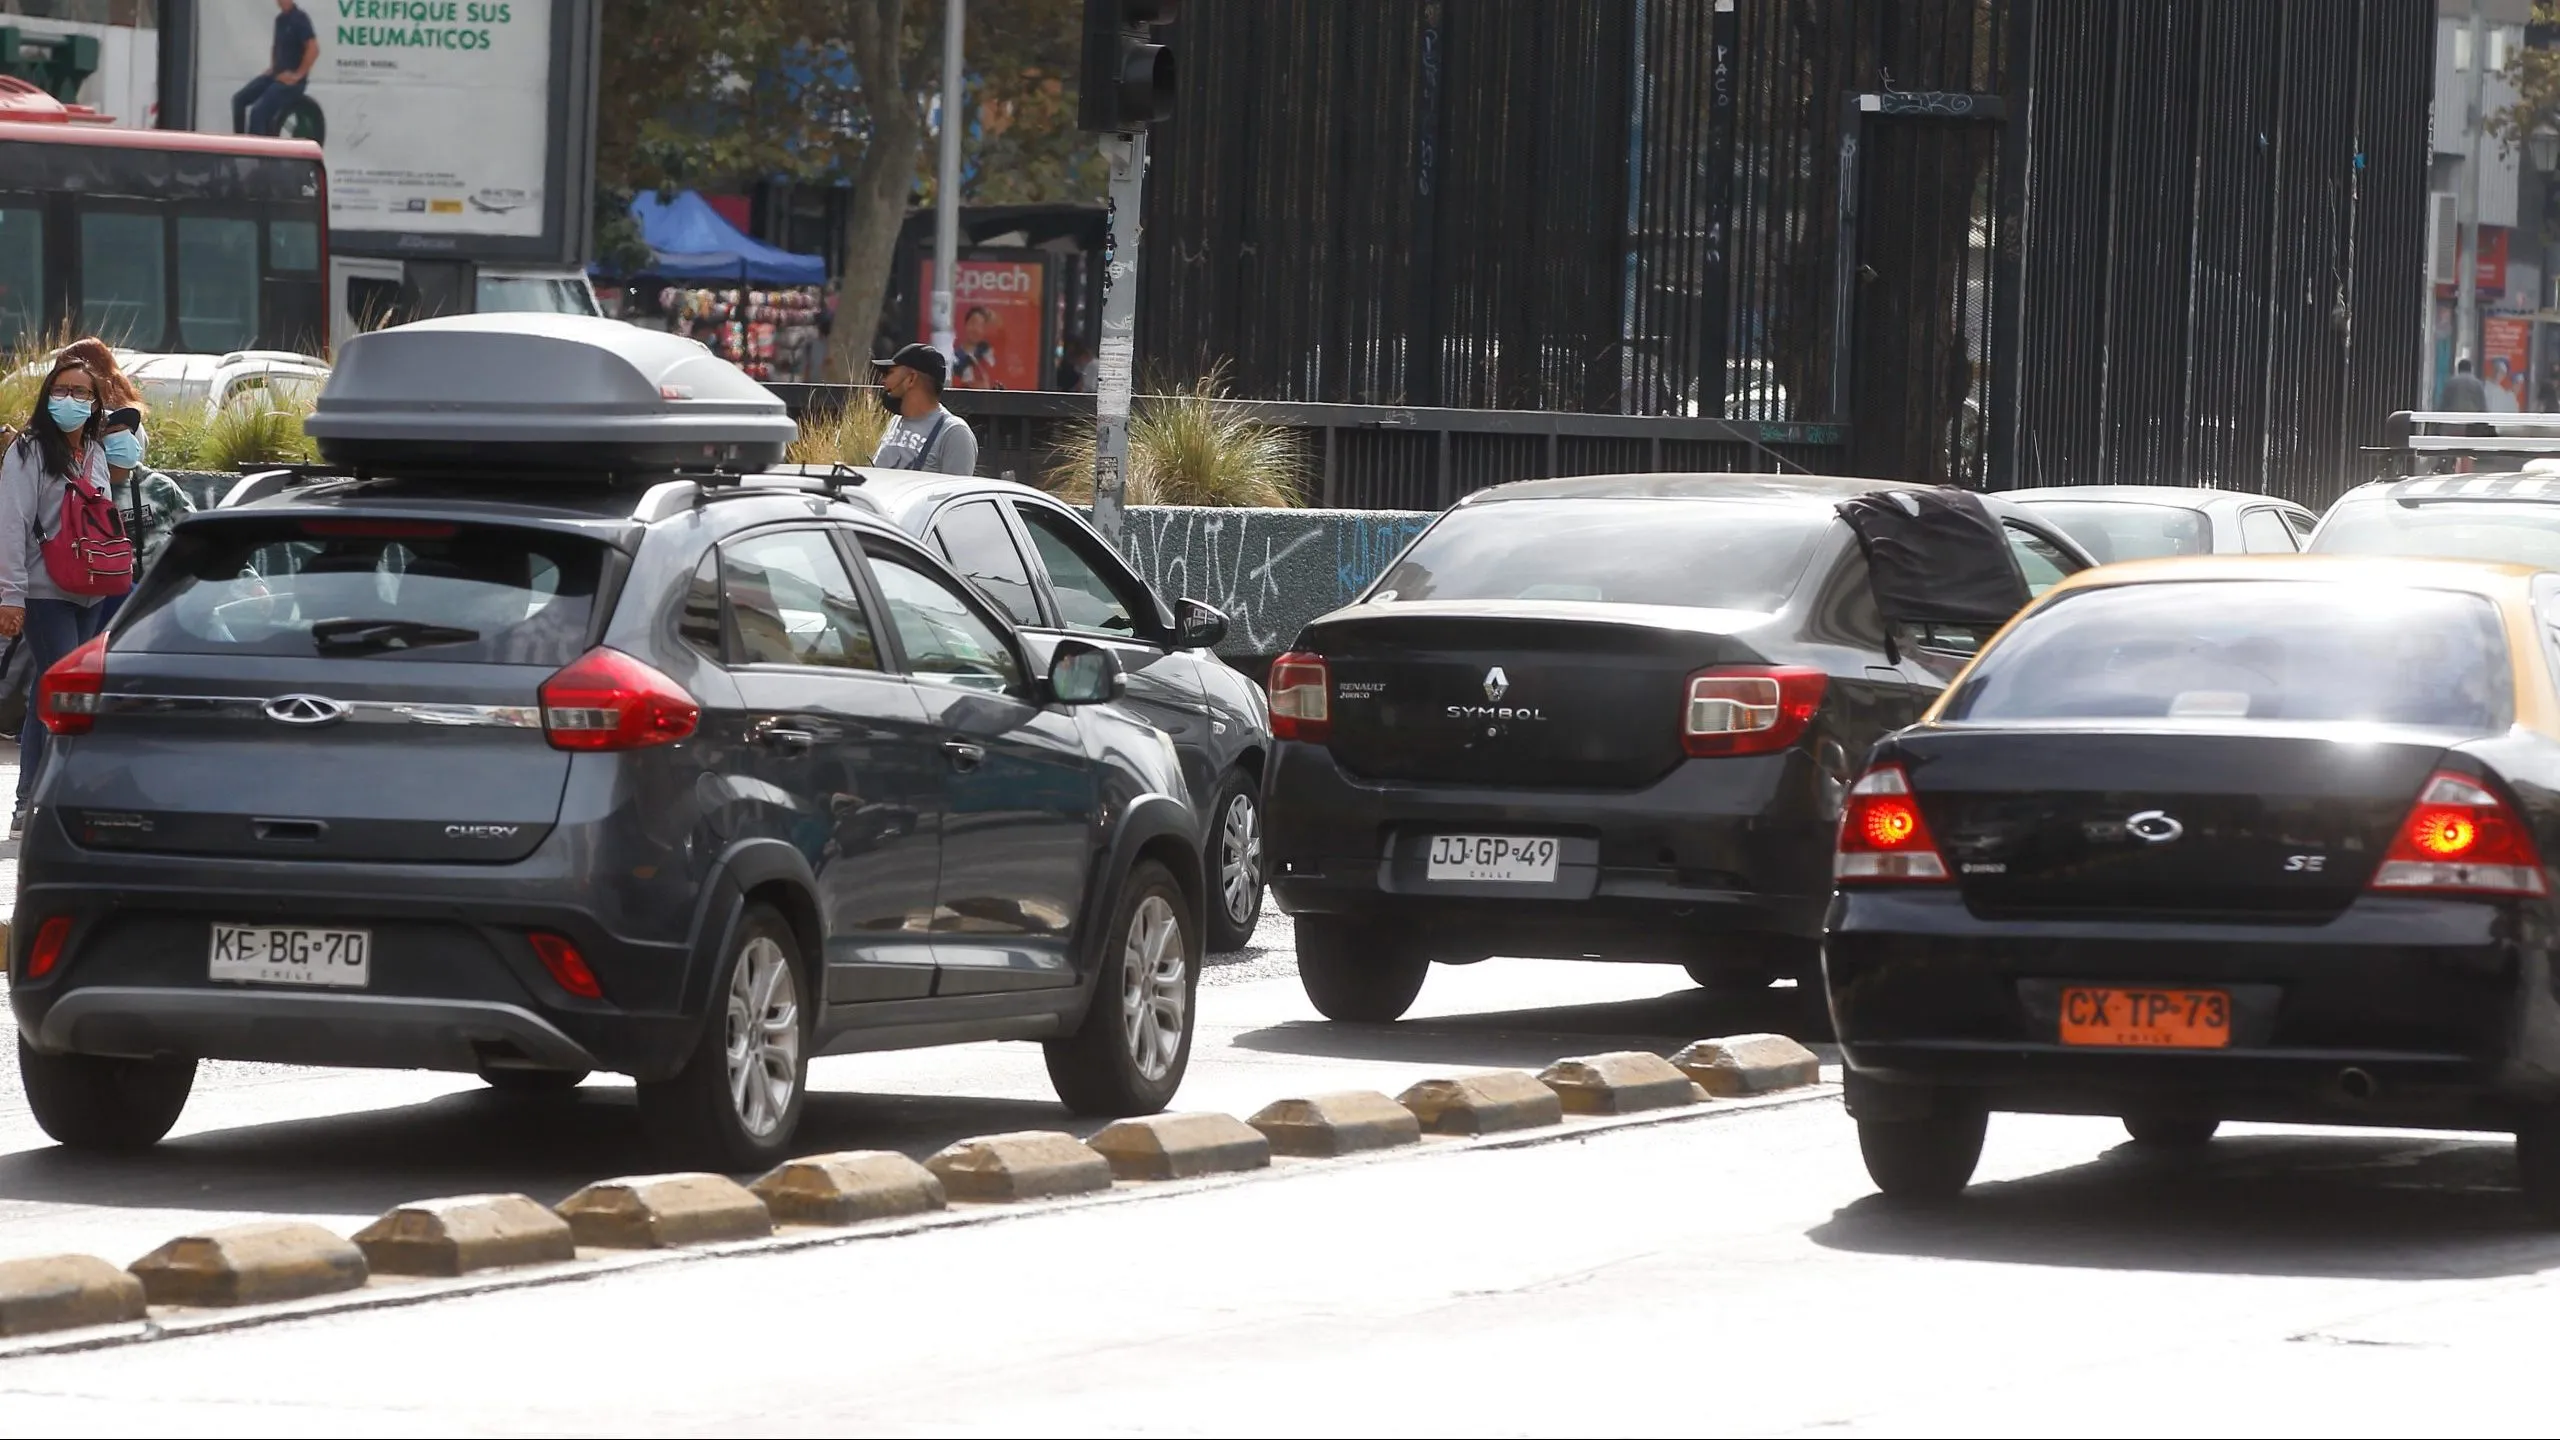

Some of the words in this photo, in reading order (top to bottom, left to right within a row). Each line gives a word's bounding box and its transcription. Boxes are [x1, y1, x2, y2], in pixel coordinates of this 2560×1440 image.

[338, 0, 457, 21] VERIFIQUE
[466, 2, 512, 23] SUS
[336, 23, 492, 50] NEUMÁTICOS
[1340, 682, 1386, 692] RENAULT
[1446, 706, 1547, 721] SYMBOL
[444, 825, 519, 840] CHERY
[2283, 855, 2327, 872] SE
